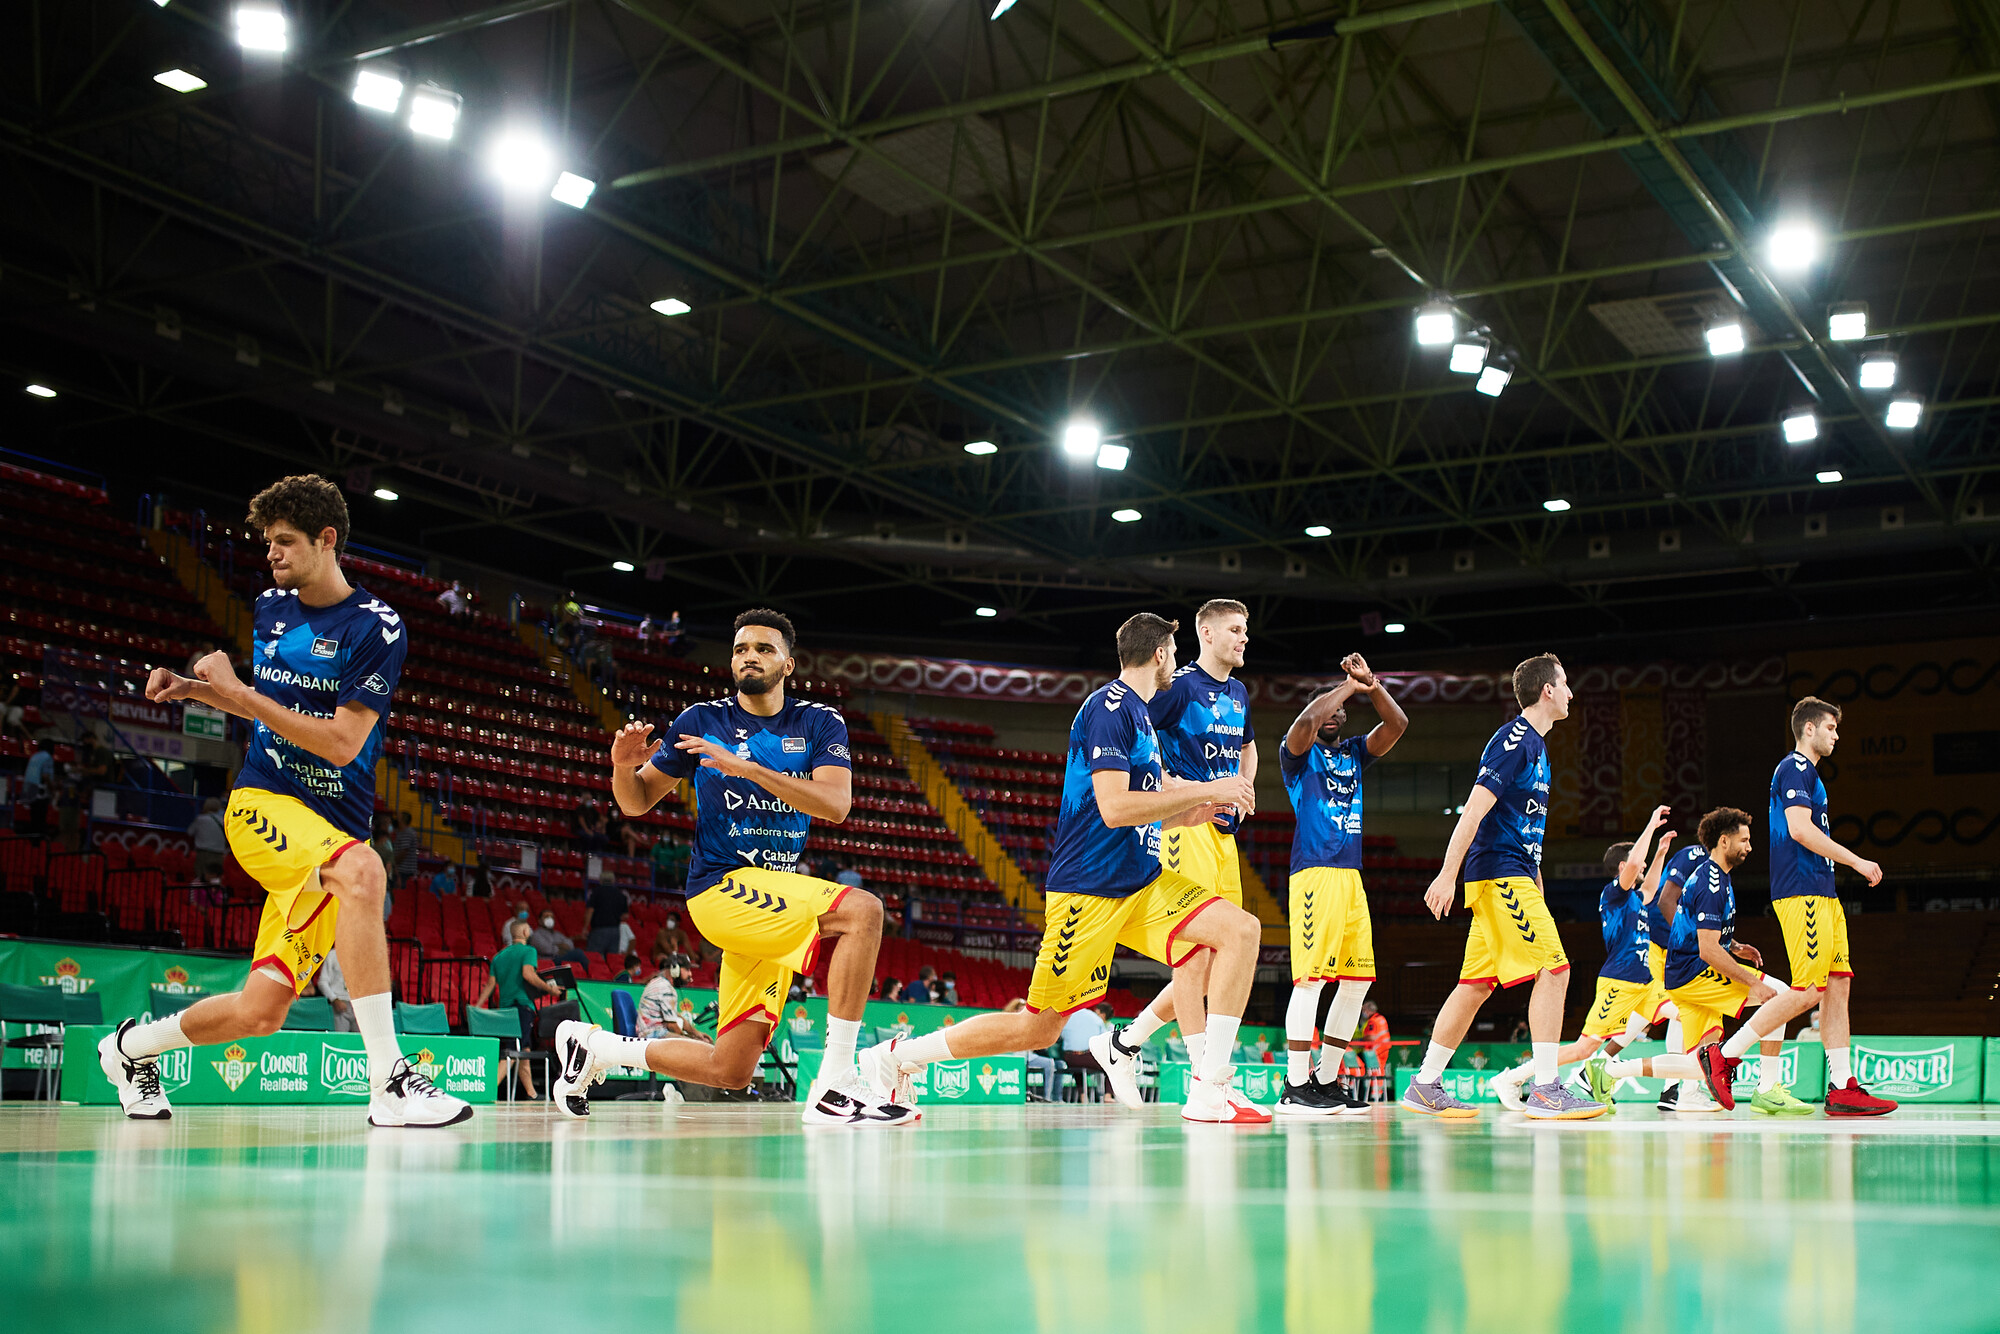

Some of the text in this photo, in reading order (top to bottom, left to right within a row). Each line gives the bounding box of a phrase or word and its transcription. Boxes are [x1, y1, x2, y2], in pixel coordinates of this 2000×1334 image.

[364, 674, 384, 692] Ford
[111, 701, 170, 726] SEVILLA
[1214, 724, 1244, 737] MORABAN
[743, 827, 782, 837] andorra
[260, 1050, 309, 1077] COOSUR
[326, 1052, 370, 1083] COOS
[446, 1055, 486, 1077] COOSUR
[1859, 1054, 1949, 1084] COOSUR
[260, 1077, 309, 1092] RealBetis
[342, 1084, 369, 1092] ORIGEN
[446, 1079, 486, 1092] RealBetis
